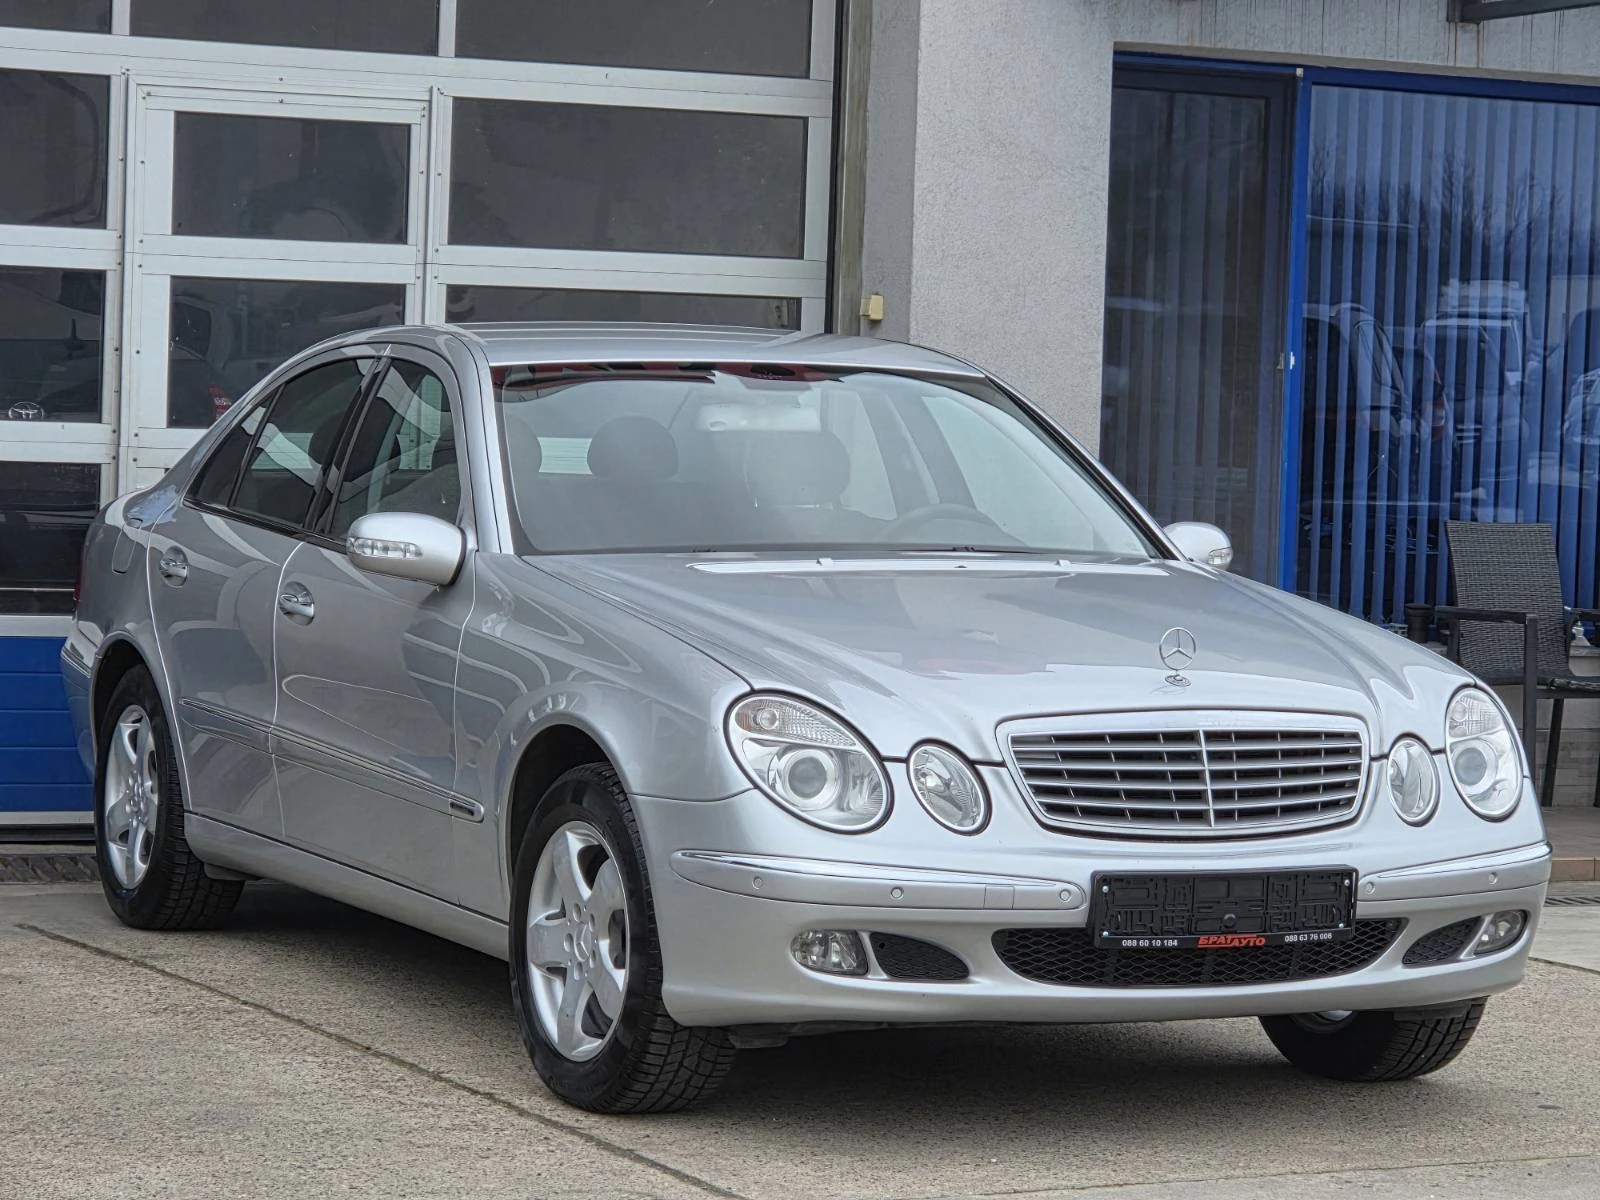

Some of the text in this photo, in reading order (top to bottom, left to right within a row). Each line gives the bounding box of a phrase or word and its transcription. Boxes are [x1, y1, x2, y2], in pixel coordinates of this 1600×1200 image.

[1299, 934, 1308, 942] 63
[1122, 939, 1178, 947] 088 60 10 184
